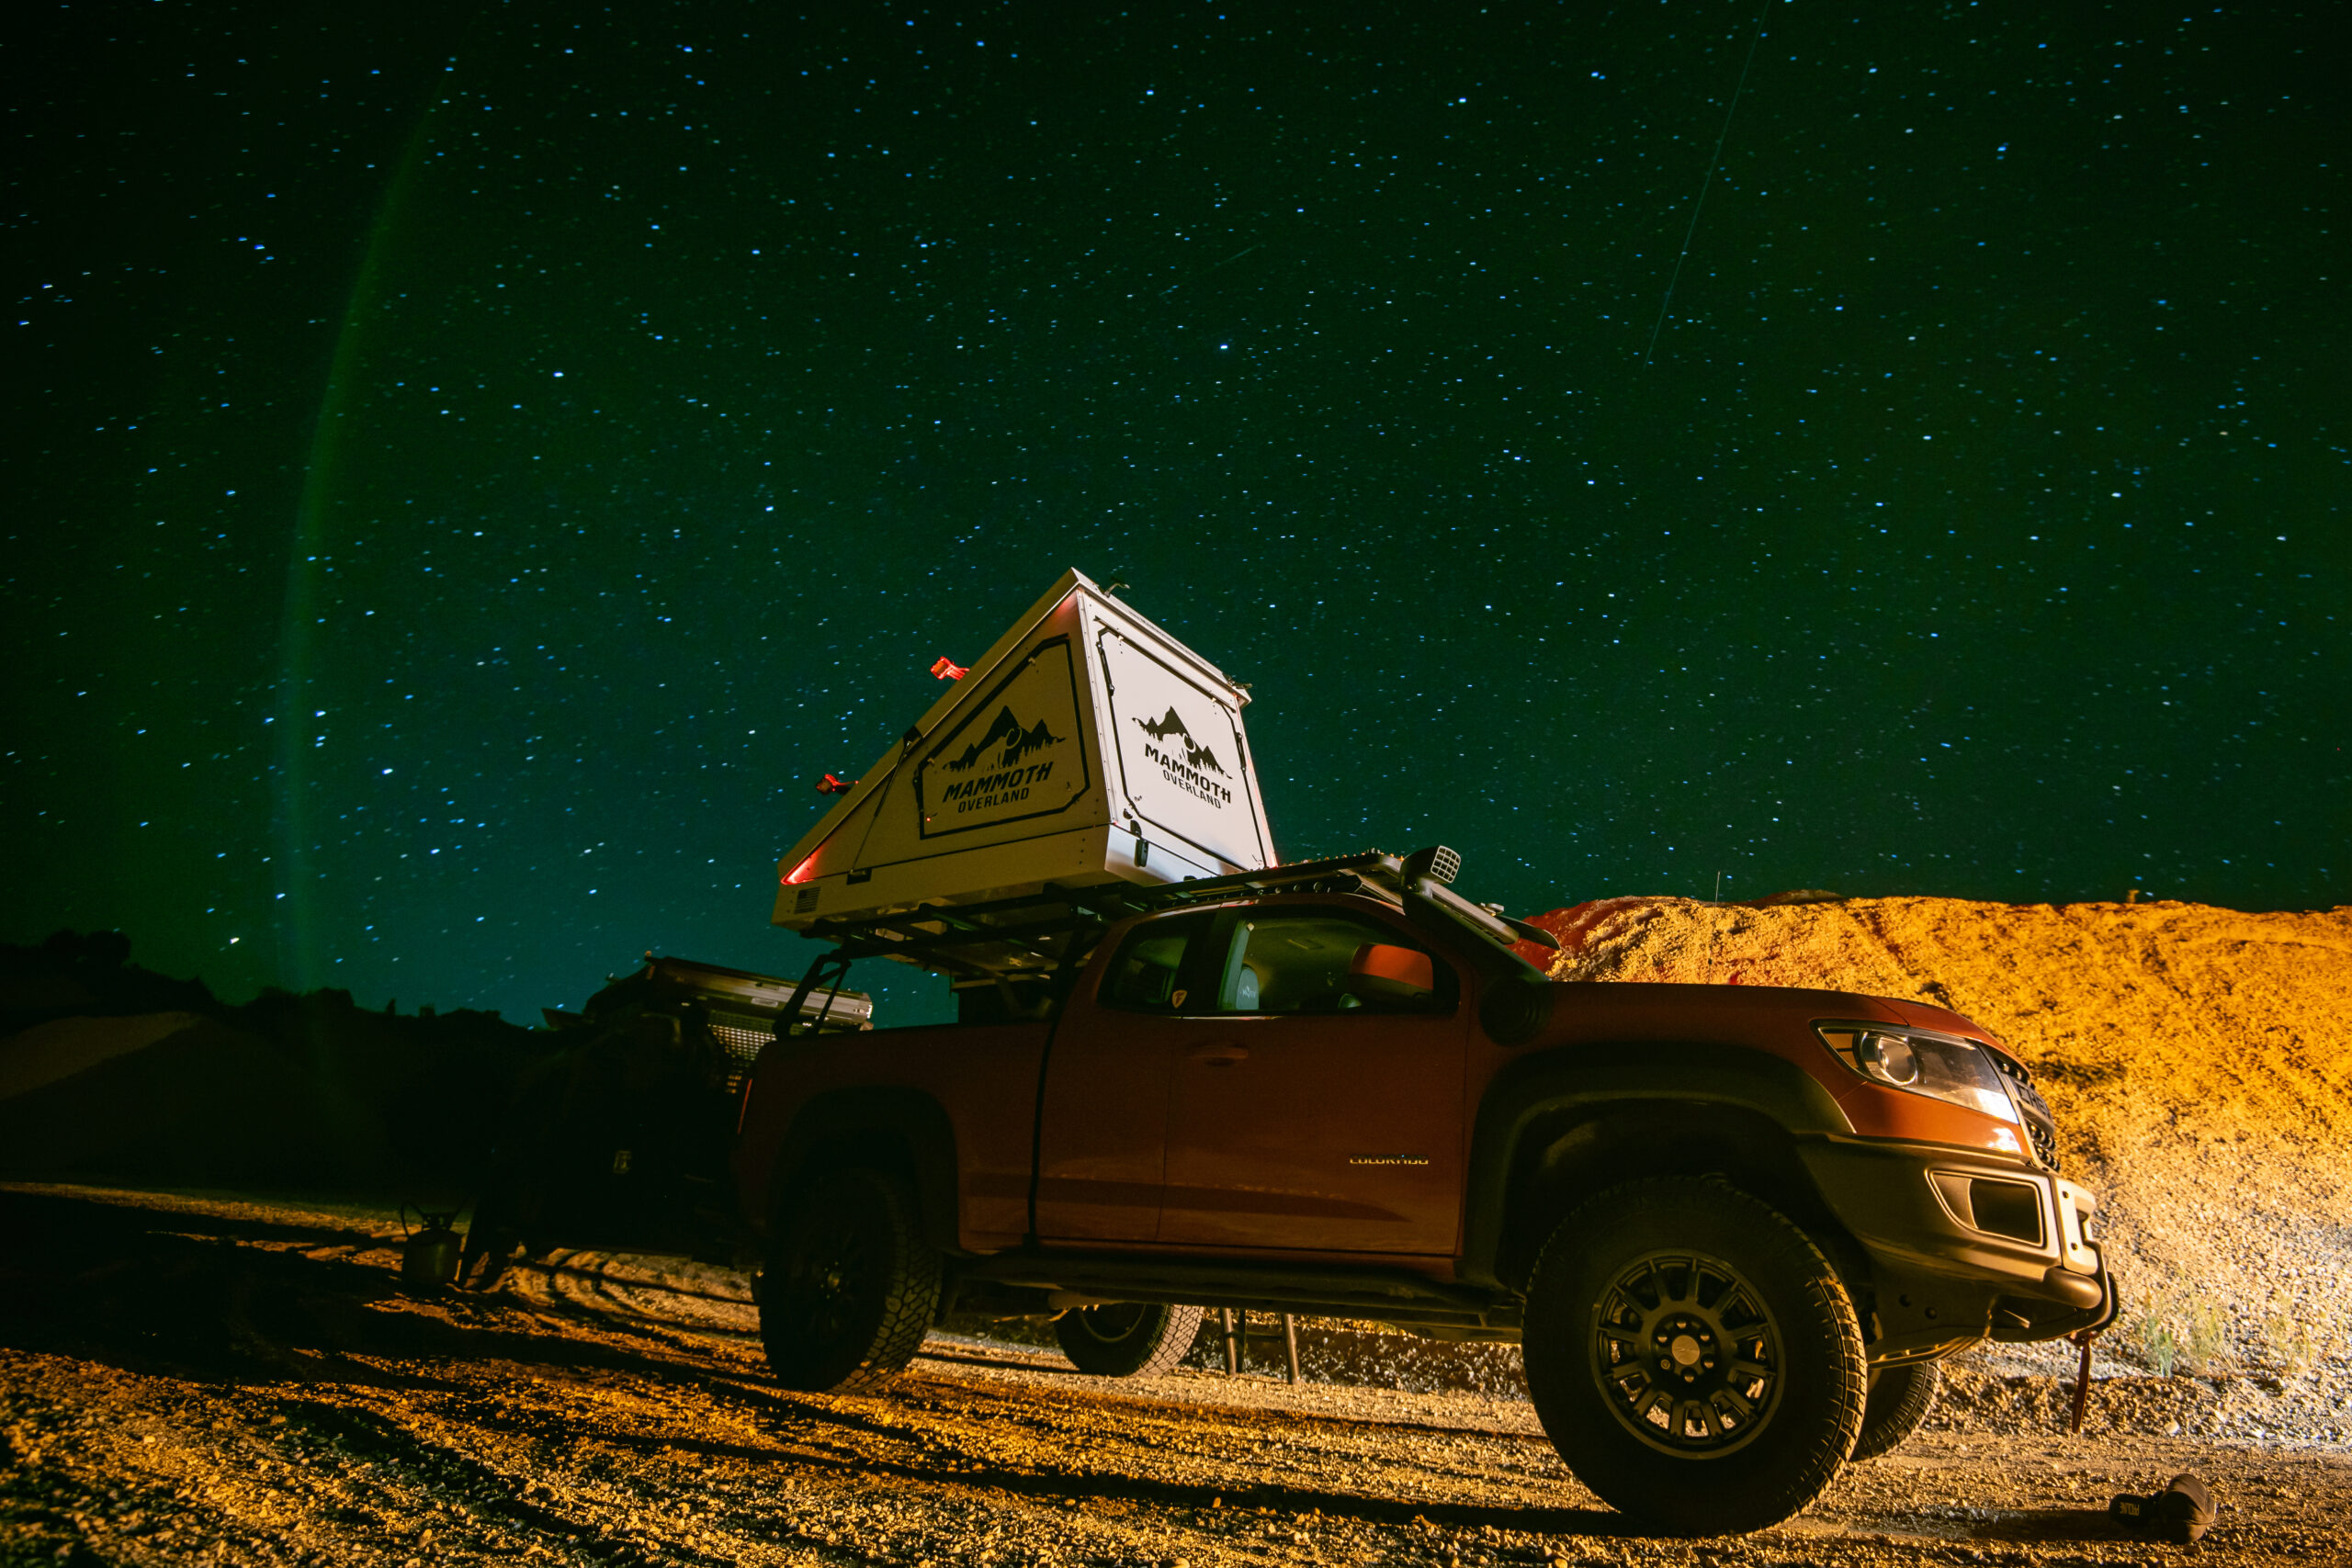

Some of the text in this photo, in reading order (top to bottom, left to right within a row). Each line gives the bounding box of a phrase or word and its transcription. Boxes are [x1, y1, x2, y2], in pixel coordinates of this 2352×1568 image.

[943, 761, 1054, 803] MAMMOTH
[1145, 743, 1231, 804] MAMMOTH
[1162, 770, 1221, 809] OVERLAND
[958, 787, 1030, 813] OVERLAND
[1349, 1154, 1430, 1165] COLORADO
